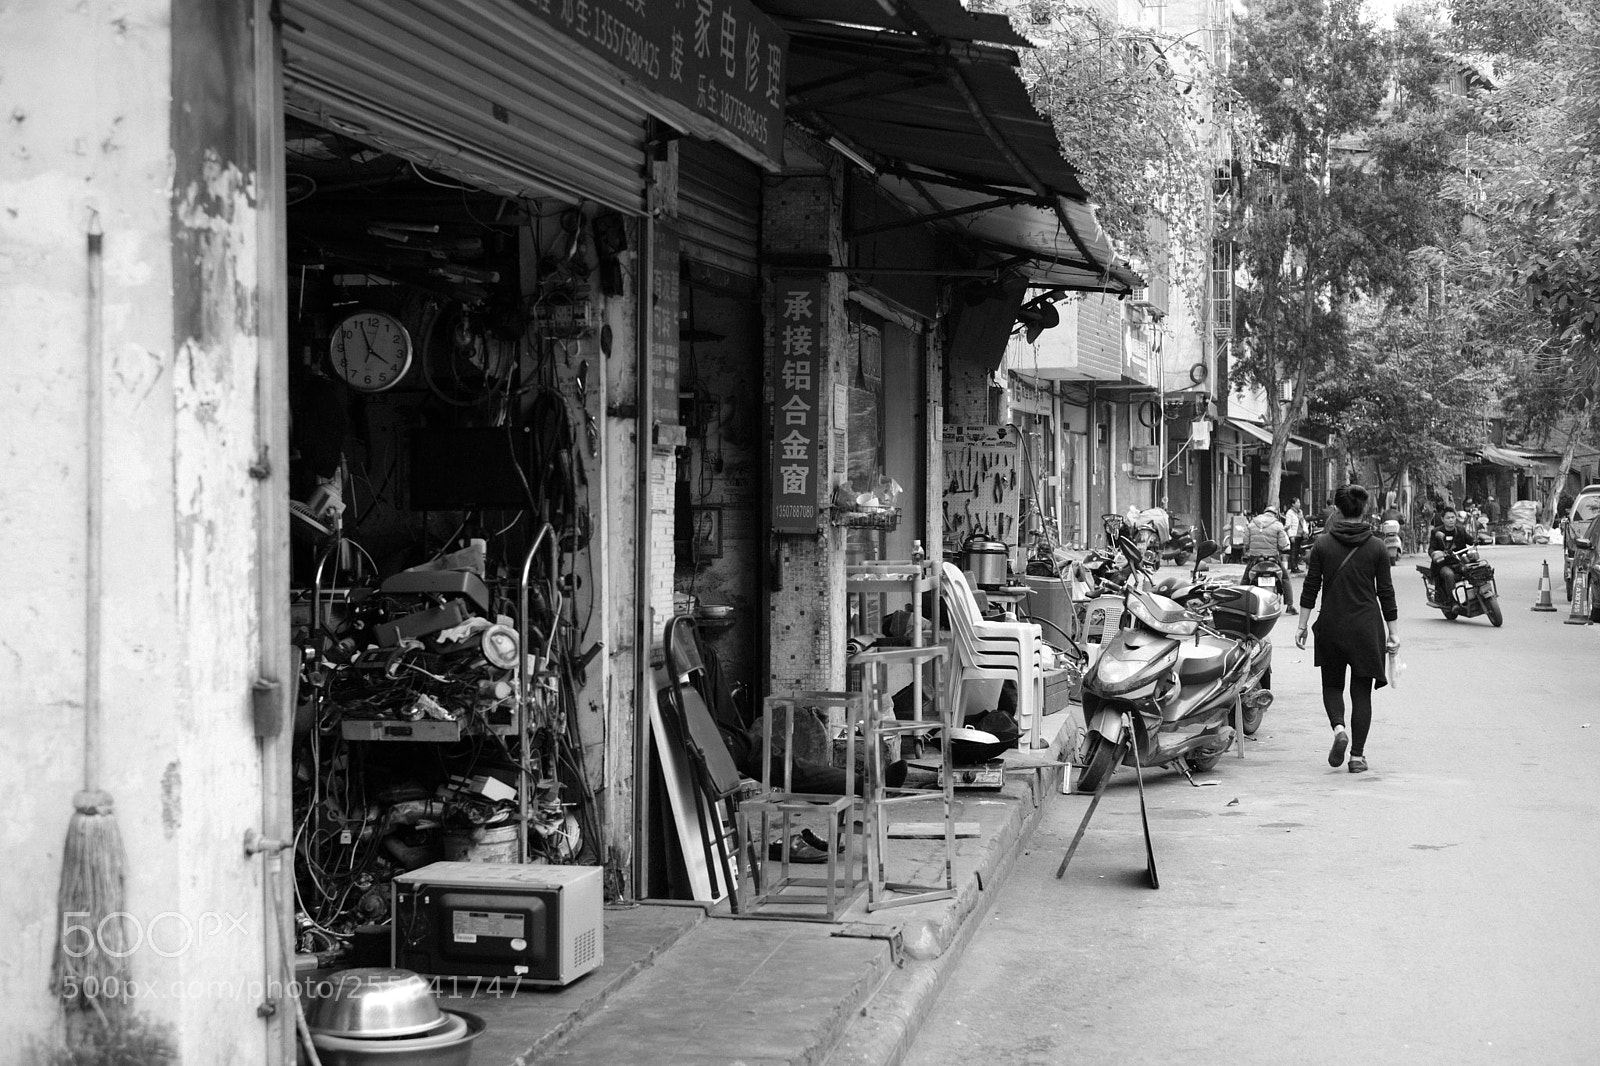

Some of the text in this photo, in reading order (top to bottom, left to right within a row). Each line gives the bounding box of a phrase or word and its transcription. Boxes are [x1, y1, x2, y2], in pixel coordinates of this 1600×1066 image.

[694, 0, 782, 109] 家电修理
[367, 317, 379, 328] 12
[384, 324, 390, 333] 1
[393, 334, 401, 344] 2
[396, 349, 404, 358] 3
[390, 363, 397, 372] 4
[350, 369, 358, 378] 7
[379, 372, 387, 382] 5
[364, 375, 372, 384] 6
[780, 290, 813, 495] 承接铝合金窗
